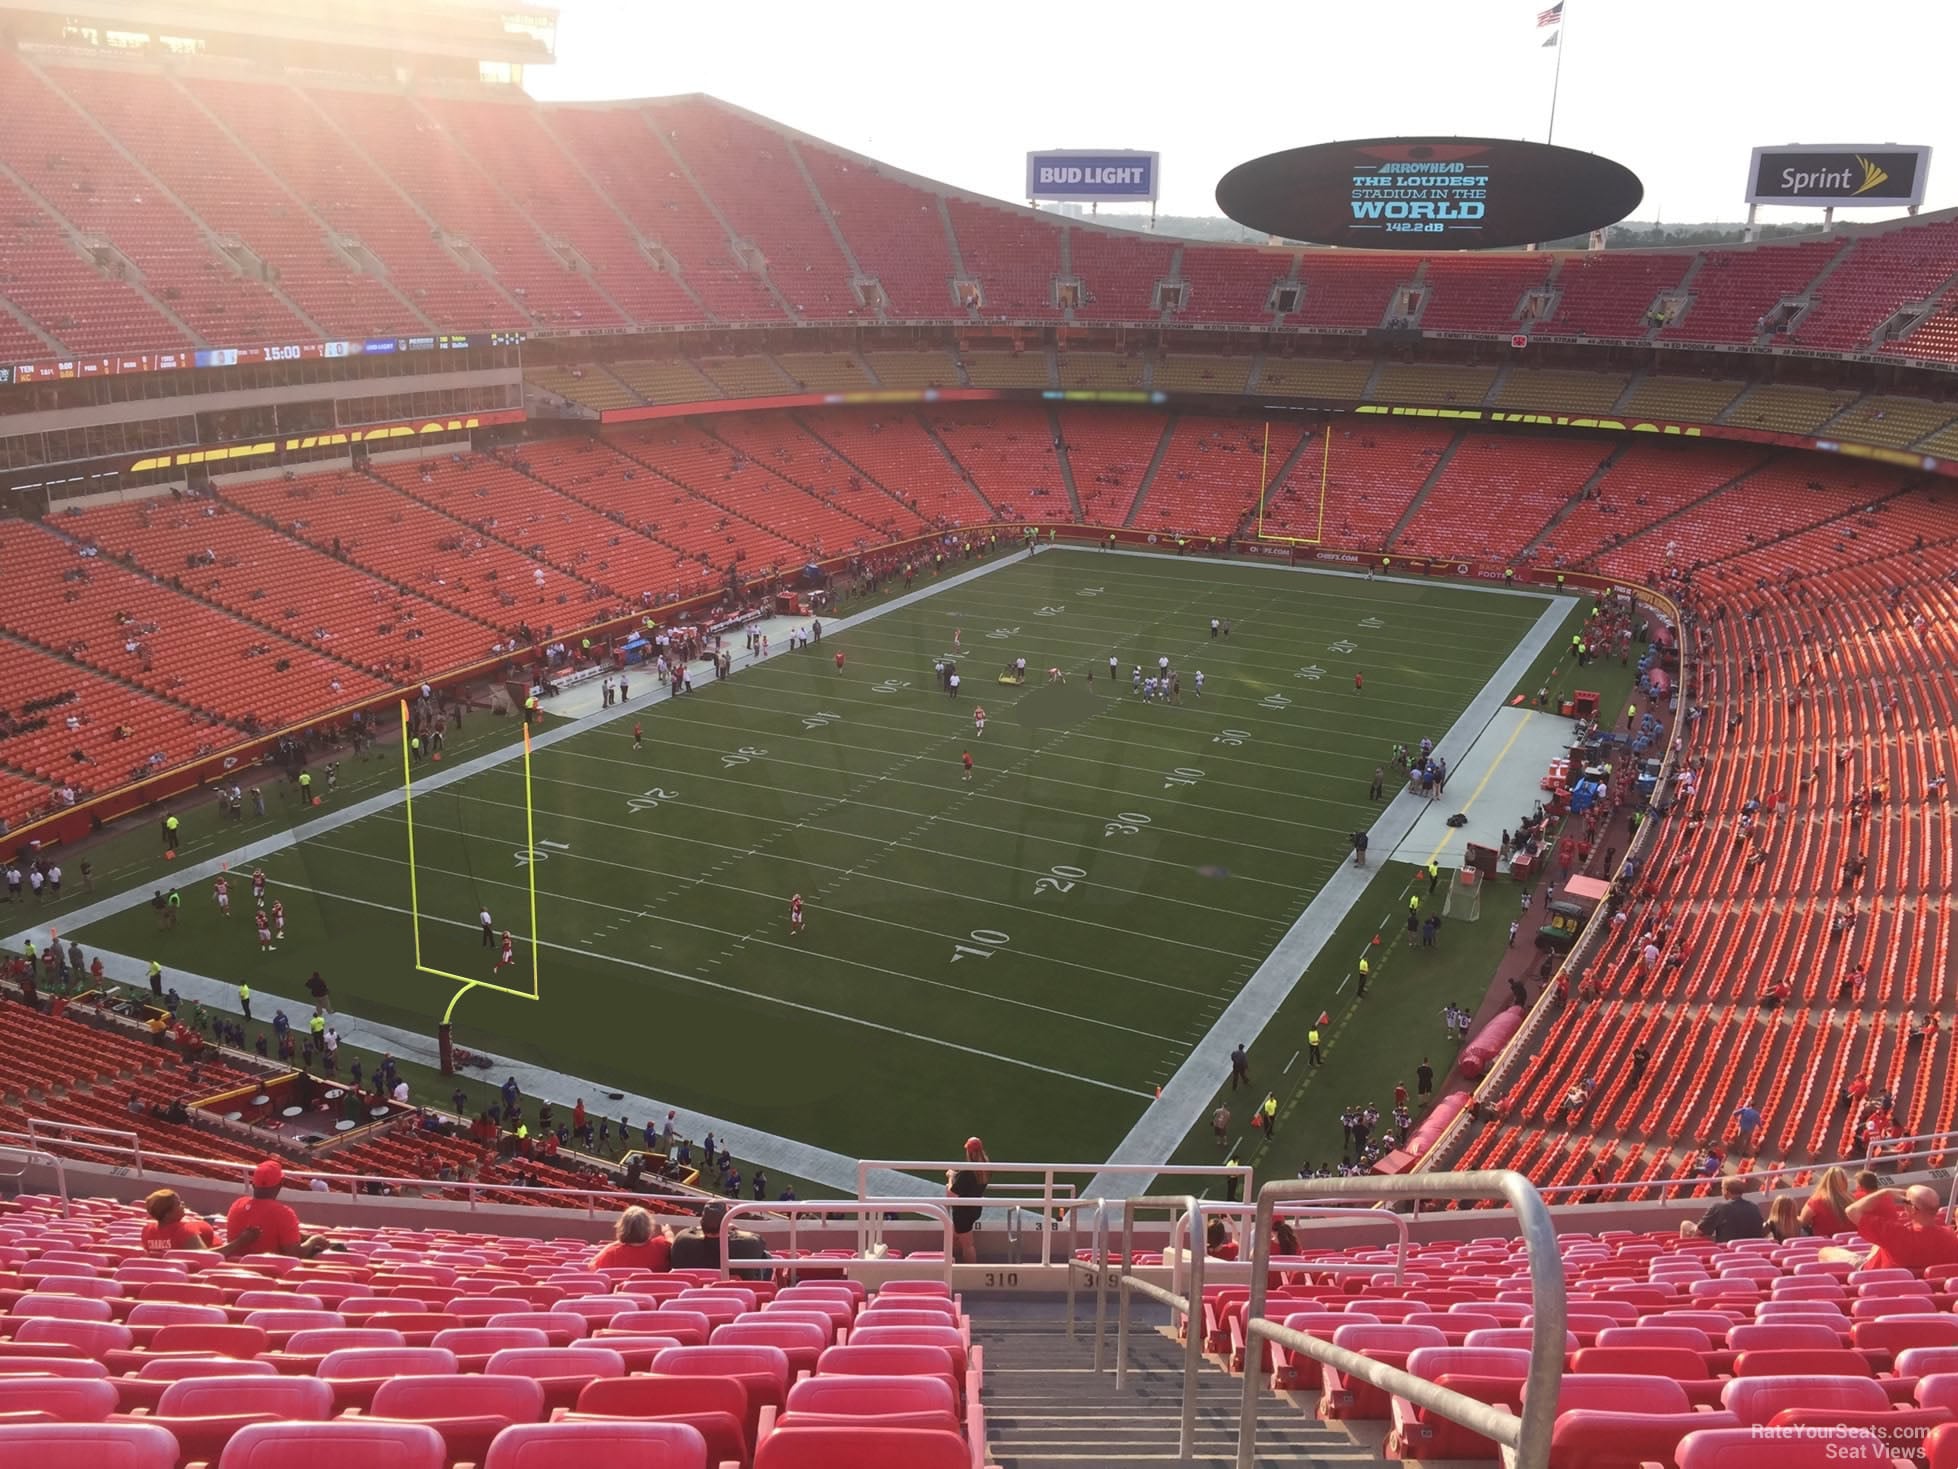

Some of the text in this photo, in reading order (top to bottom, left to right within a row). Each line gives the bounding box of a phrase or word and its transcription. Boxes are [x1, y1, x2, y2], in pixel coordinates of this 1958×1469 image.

[1040, 167, 1144, 184] BUD LIGHT
[1377, 162, 1465, 174] ARROWHEAD
[1352, 176, 1489, 187] THE LOUDEST
[1781, 168, 1852, 194] Sprint
[1352, 189, 1486, 199] STADIUM IN THE
[1351, 201, 1486, 220] WORLD
[263, 345, 301, 361] 15:00
[19, 365, 34, 373] TEN
[20, 373, 31, 382] KC
[1478, 570, 1523, 581] FOOTLL
[1222, 729, 1251, 746] 50
[721, 746, 768, 764] 30
[1165, 768, 1205, 785] 40
[626, 787, 679, 809] 20
[1105, 812, 1151, 834] 30
[514, 839, 570, 861] 10
[1036, 865, 1087, 893] 20
[955, 929, 1010, 959] 10
[1035, 1222, 1059, 1231] 39
[985, 1273, 1018, 1288] 310
